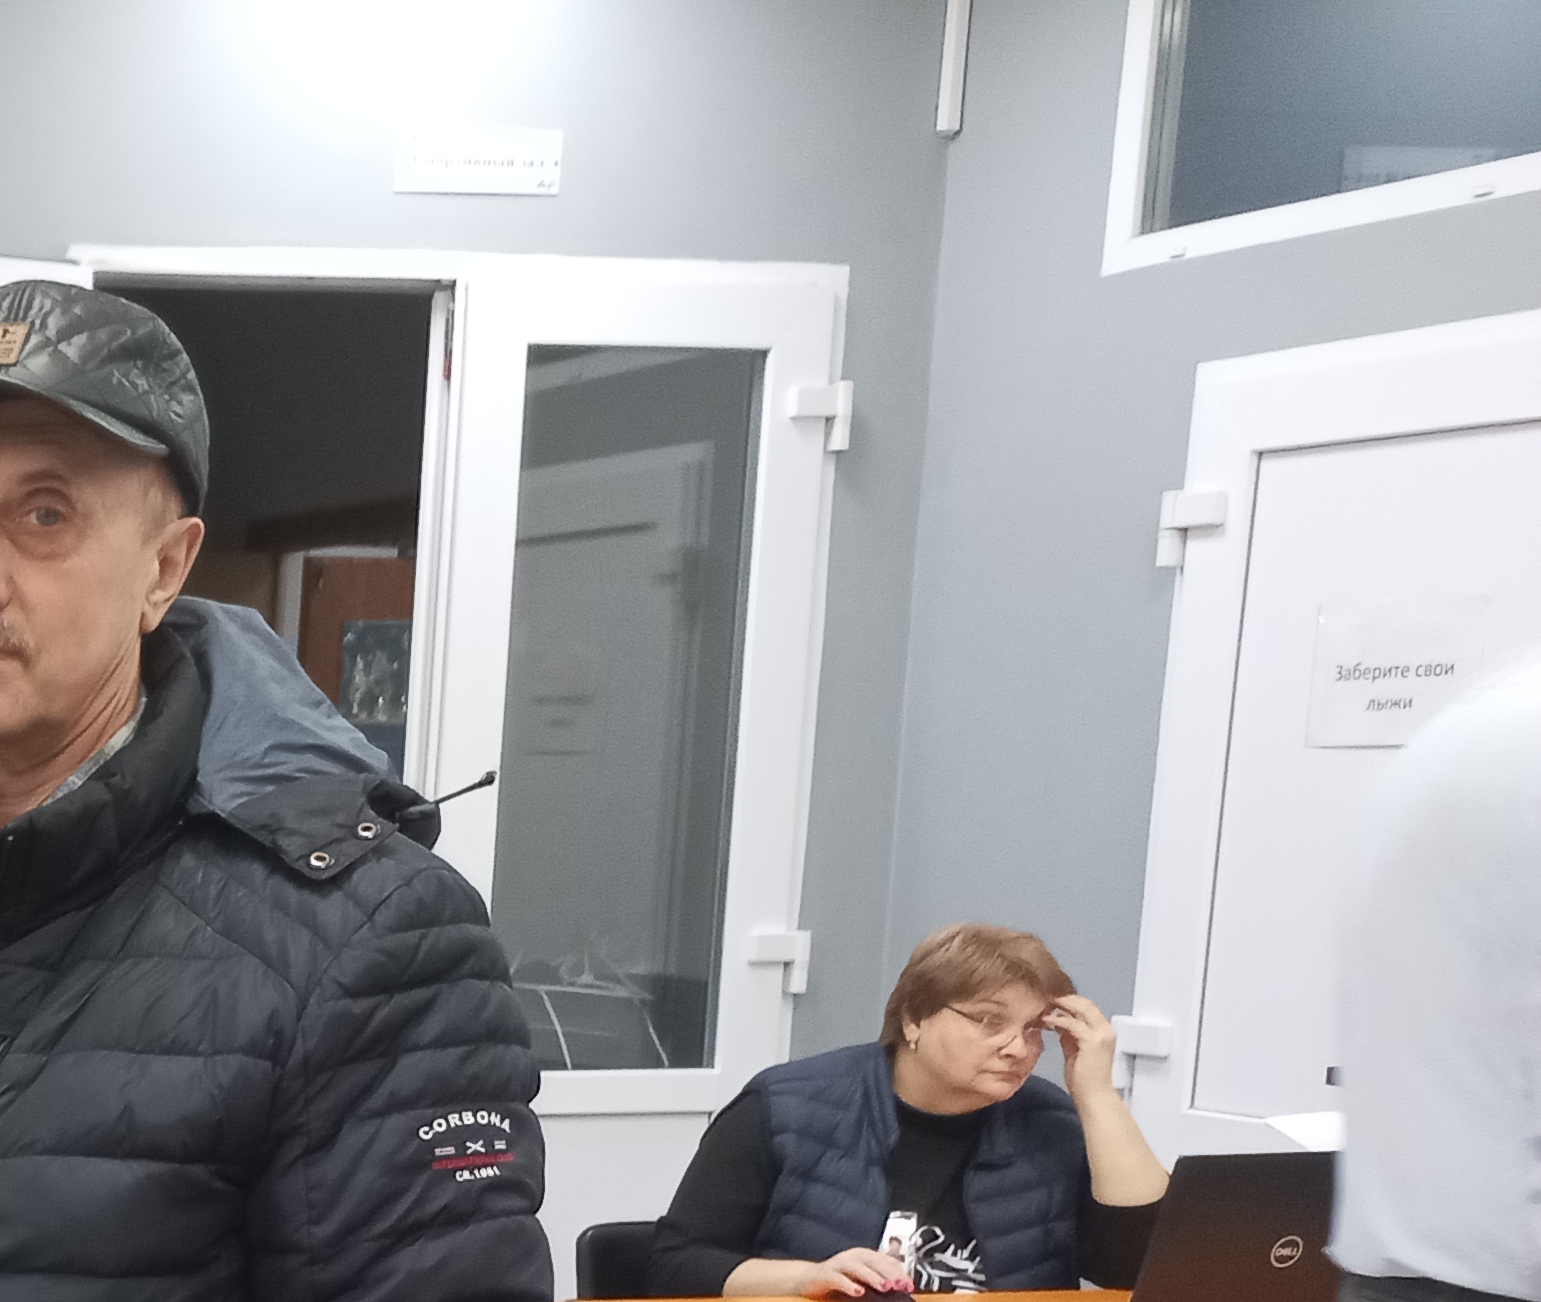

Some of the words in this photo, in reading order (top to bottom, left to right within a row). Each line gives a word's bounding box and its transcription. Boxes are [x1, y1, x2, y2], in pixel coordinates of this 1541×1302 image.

[1336, 662, 1410, 683] Заберите
[1415, 663, 1455, 677] свои
[1366, 698, 1413, 711] лыжи
[418, 1110, 511, 1140] CORBONA
